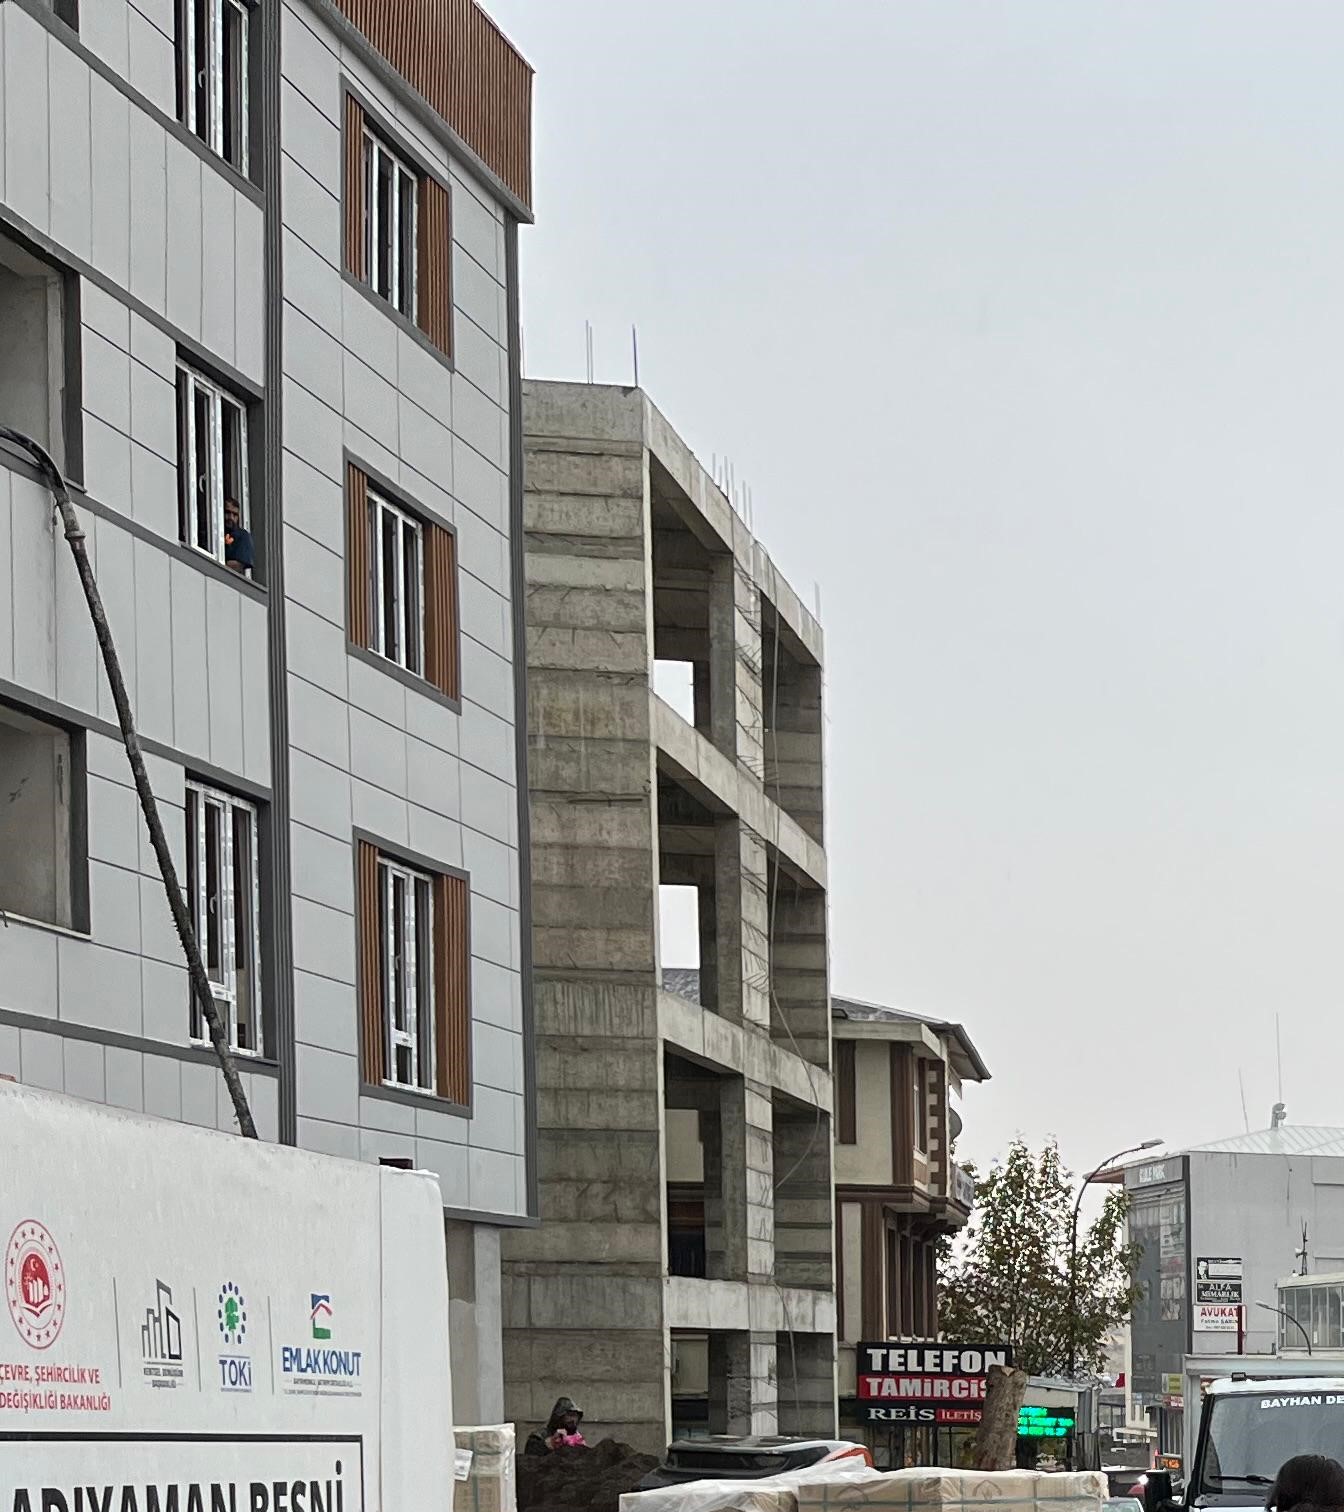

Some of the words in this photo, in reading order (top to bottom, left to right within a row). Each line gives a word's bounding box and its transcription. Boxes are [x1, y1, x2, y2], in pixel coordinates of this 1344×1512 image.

[282, 1346, 321, 1374] EMLAK
[323, 1349, 362, 1377] KONUT
[867, 1348, 1006, 1373] TELEFON
[35, 1363, 87, 1386] ŞEHİRCİLİK
[88, 1369, 101, 1384] VE
[60, 1392, 112, 1411] BAKANLIĞI
[1260, 1395, 1322, 1409] BAYHAN
[867, 1406, 935, 1421] REİS
